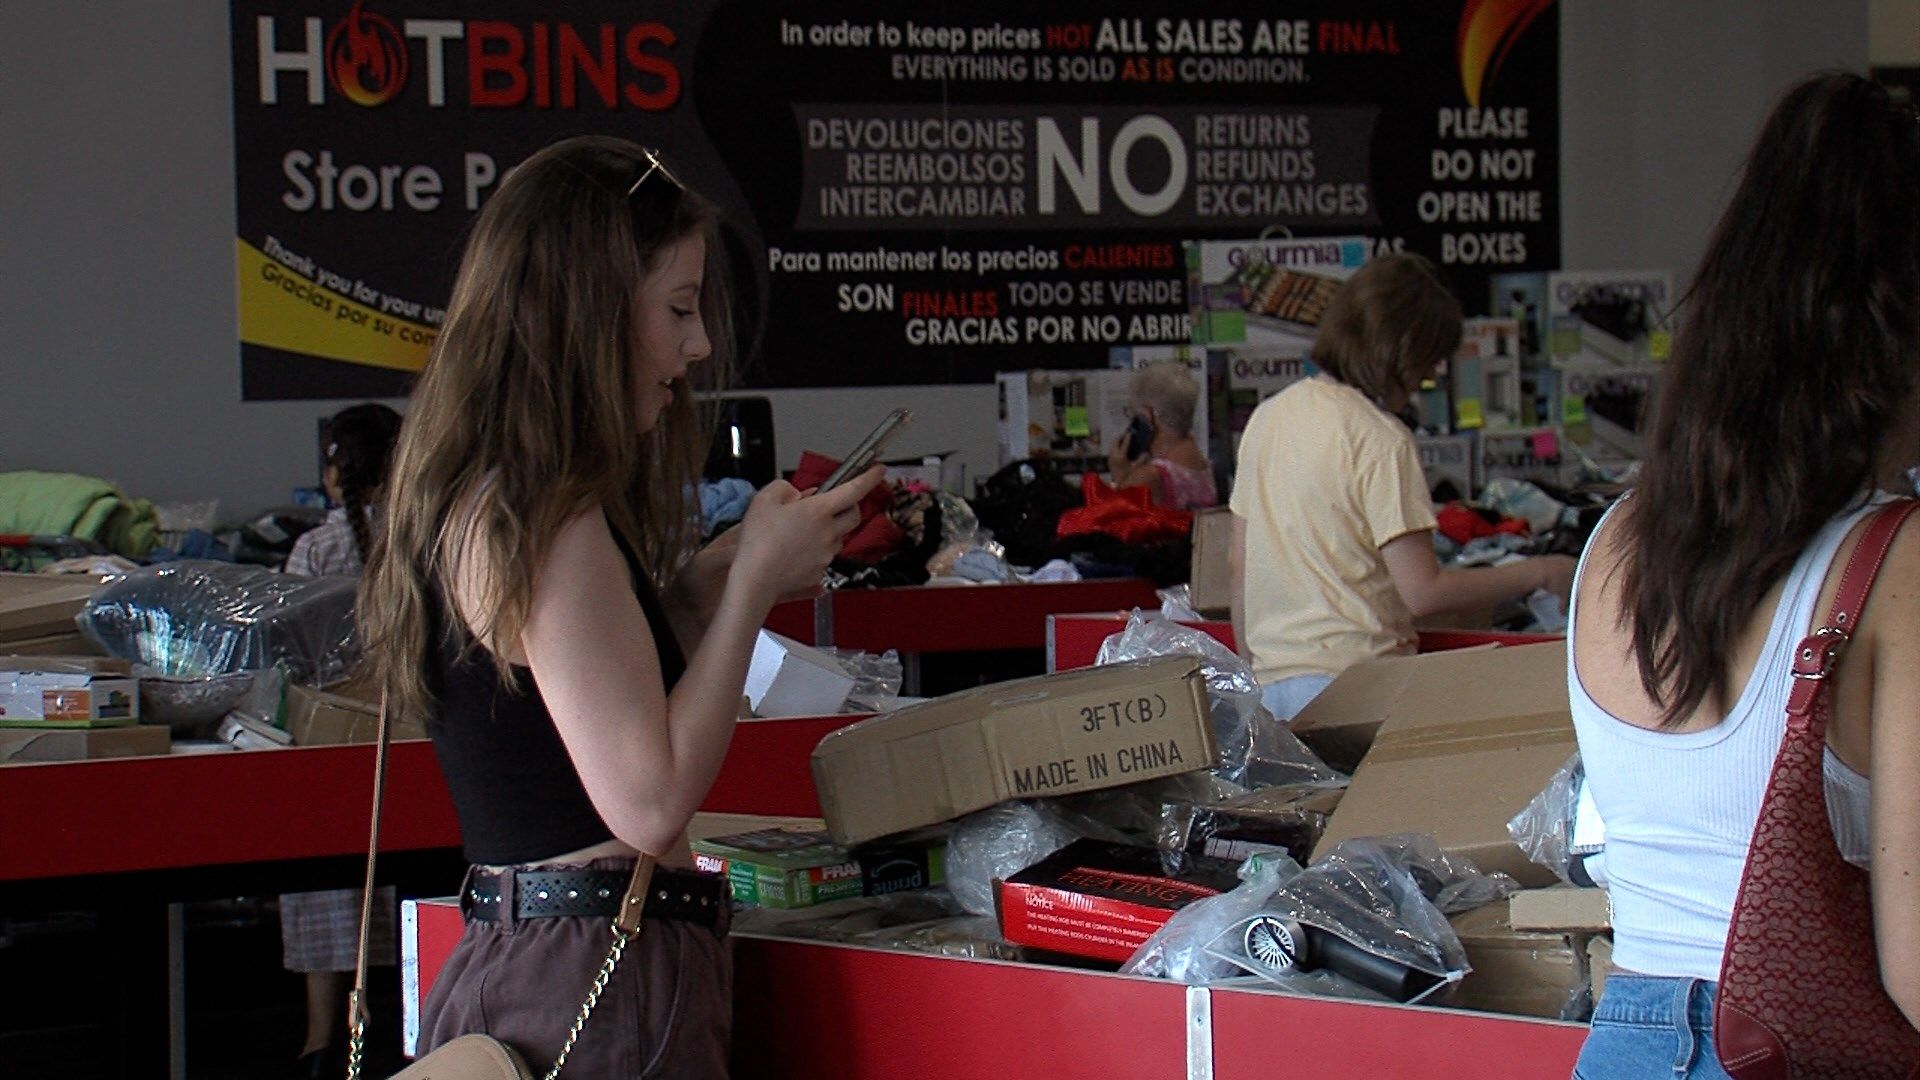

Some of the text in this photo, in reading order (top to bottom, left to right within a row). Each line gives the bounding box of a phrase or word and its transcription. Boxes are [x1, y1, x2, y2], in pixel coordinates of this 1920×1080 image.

[781, 19, 1092, 53] In order to keep prices HOT
[1095, 18, 1400, 54] ALL SALES ARE FINAL
[891, 54, 1028, 81] EVERYTHING
[1033, 55, 1053, 82] IS
[1058, 56, 1116, 82] SOLD
[1121, 57, 1150, 82] AS
[1155, 57, 1175, 82] IS
[808, 118, 1025, 150] DEVOLUCIONES
[1195, 114, 1311, 146] RETURNS
[1438, 106, 1528, 139] PLEASE
[282, 149, 443, 211] Store
[846, 152, 1025, 183] REEMBOLSOS
[1036, 114, 1188, 216] NO
[1195, 149, 1316, 181] REFUNDS
[1431, 148, 1536, 181] DO NOT
[820, 186, 1025, 217] INTERCAMBIAR
[1195, 183, 1369, 217] EXCHANGES
[1417, 190, 1541, 223] OPEN THE
[768, 243, 1174, 275] Para mantener los precios CALIENTES
[1441, 232, 1527, 264] BOXES
[263, 233, 317, 280] Thank
[315, 266, 353, 295] you
[352, 279, 381, 306] for
[380, 292, 423, 318] your
[260, 262, 396, 336] Gracias por su
[838, 279, 1182, 318] SON FINALES TODO SE VENDE
[905, 317, 1019, 345] GRACIAS
[1025, 315, 1075, 343] POR
[1082, 314, 1121, 342] NO
[1080, 693, 1167, 733] 3FT(B)
[1013, 739, 1184, 794] MADE IN CHINA
